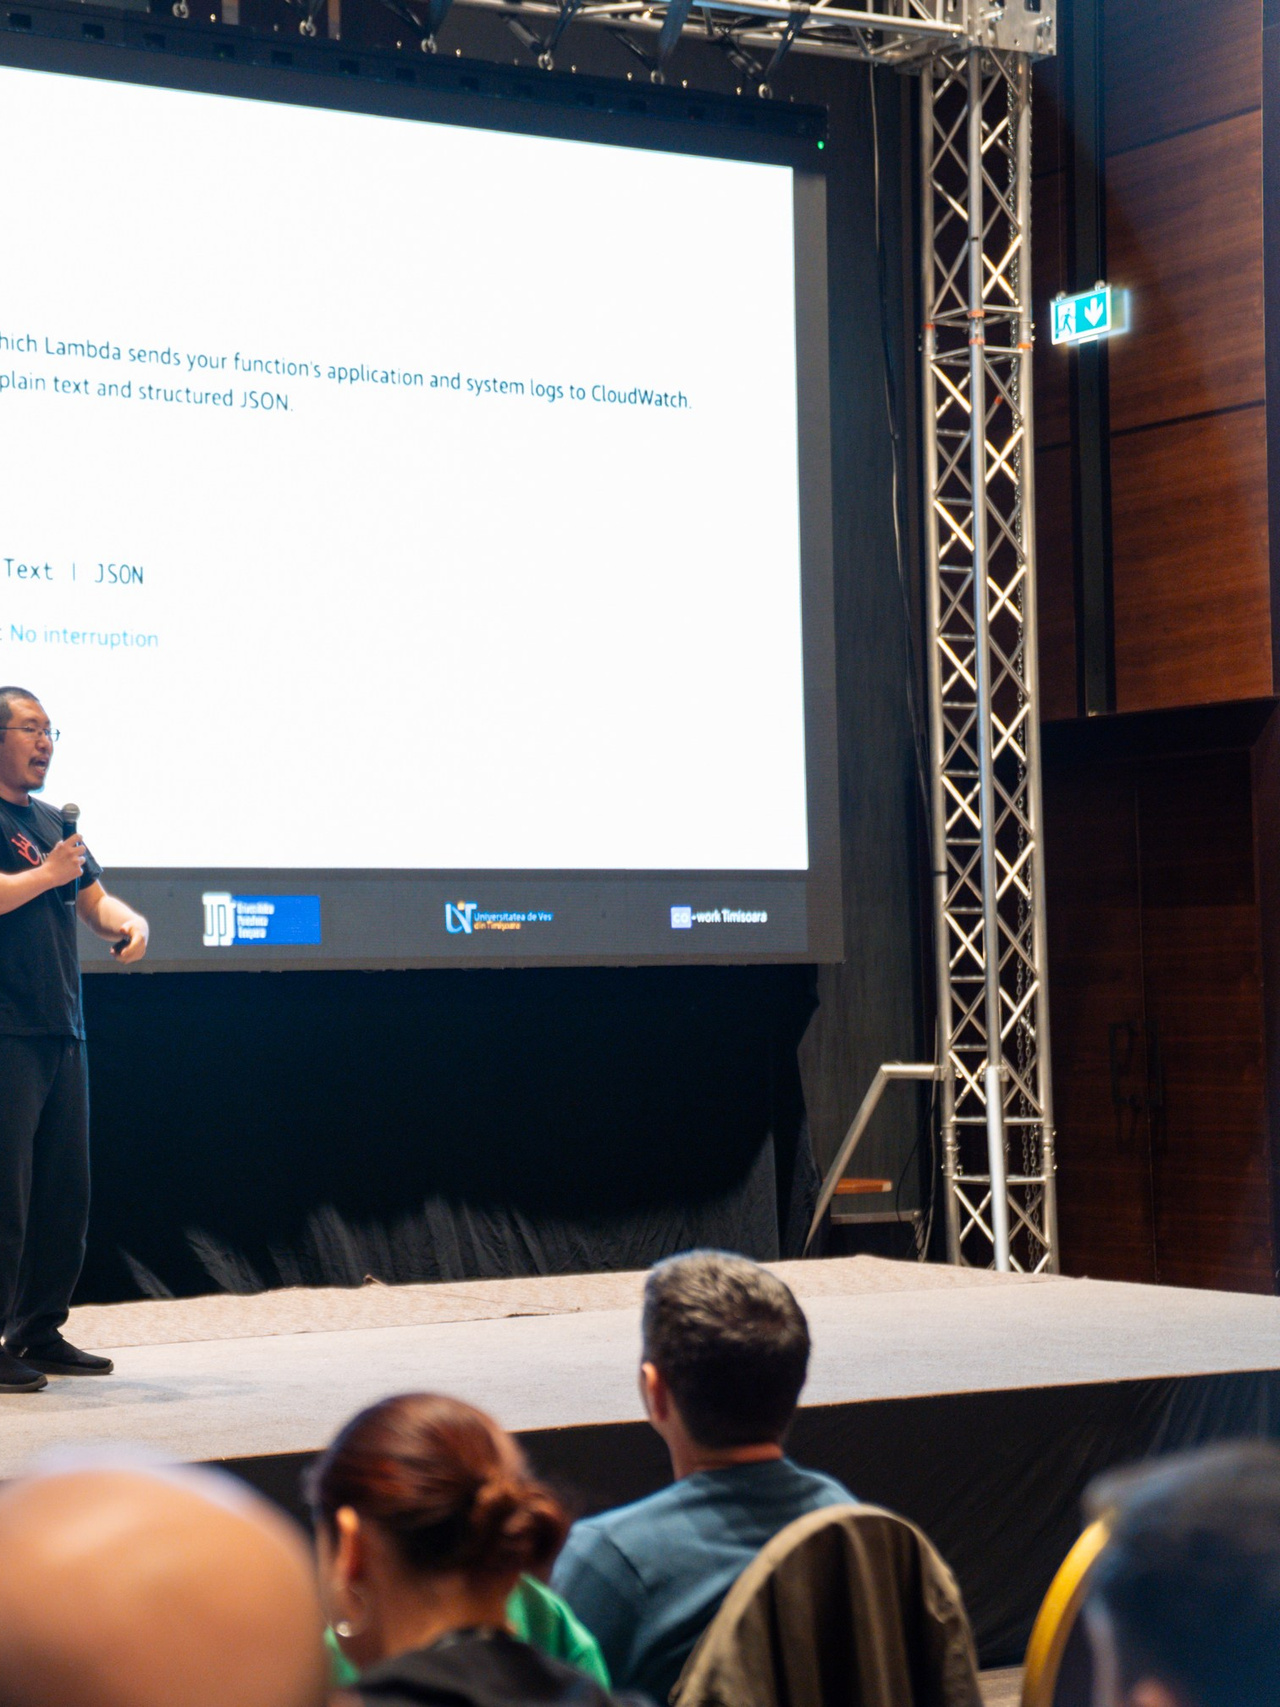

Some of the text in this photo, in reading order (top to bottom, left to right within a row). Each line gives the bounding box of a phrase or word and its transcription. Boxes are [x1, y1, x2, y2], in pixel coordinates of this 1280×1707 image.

[45, 337, 121, 360] Lambda
[128, 347, 181, 366] sends
[187, 354, 227, 371] your
[234, 352, 321, 378] function's
[328, 364, 423, 386] application
[430, 373, 460, 390] and
[467, 378, 524, 396] system
[531, 379, 564, 403] logs
[570, 385, 586, 400] to
[591, 385, 692, 409] CloudWatch.
[0, 371, 45, 392] plain
[54, 376, 89, 395] text
[97, 380, 131, 398] and
[139, 384, 233, 406] structured
[4, 558, 54, 580] Text
[95, 564, 143, 584] JSON
[11, 624, 36, 642] No
[44, 628, 158, 650] interruption
[527, 911, 538, 922] de
